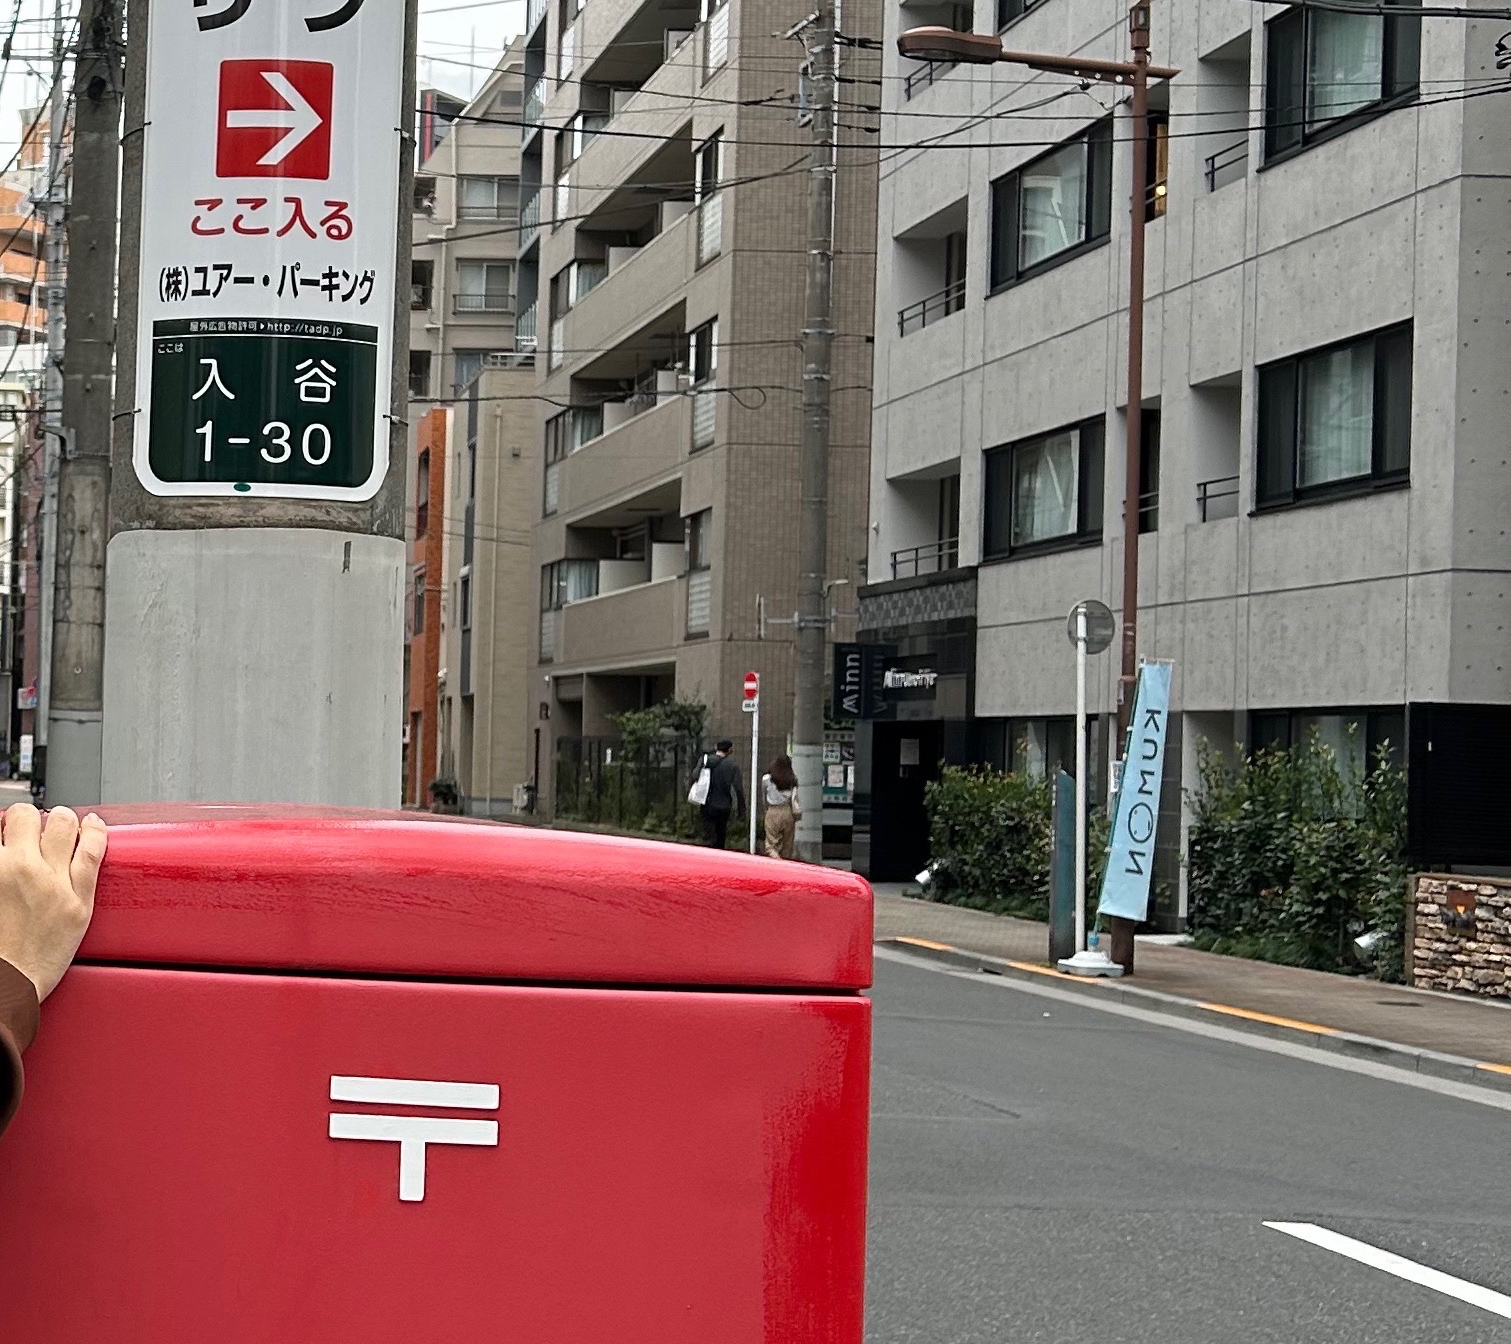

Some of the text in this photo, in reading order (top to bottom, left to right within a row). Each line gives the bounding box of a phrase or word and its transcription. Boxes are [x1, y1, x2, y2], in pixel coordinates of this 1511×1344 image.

[190, 197, 354, 241] ここ入る
[158, 262, 377, 306] (株)ユアー・パーキング
[157, 343, 184, 354] ここは
[266, 321, 343, 337] http://tadp.jp
[195, 420, 332, 466] 1-30
[839, 653, 860, 714] Minn
